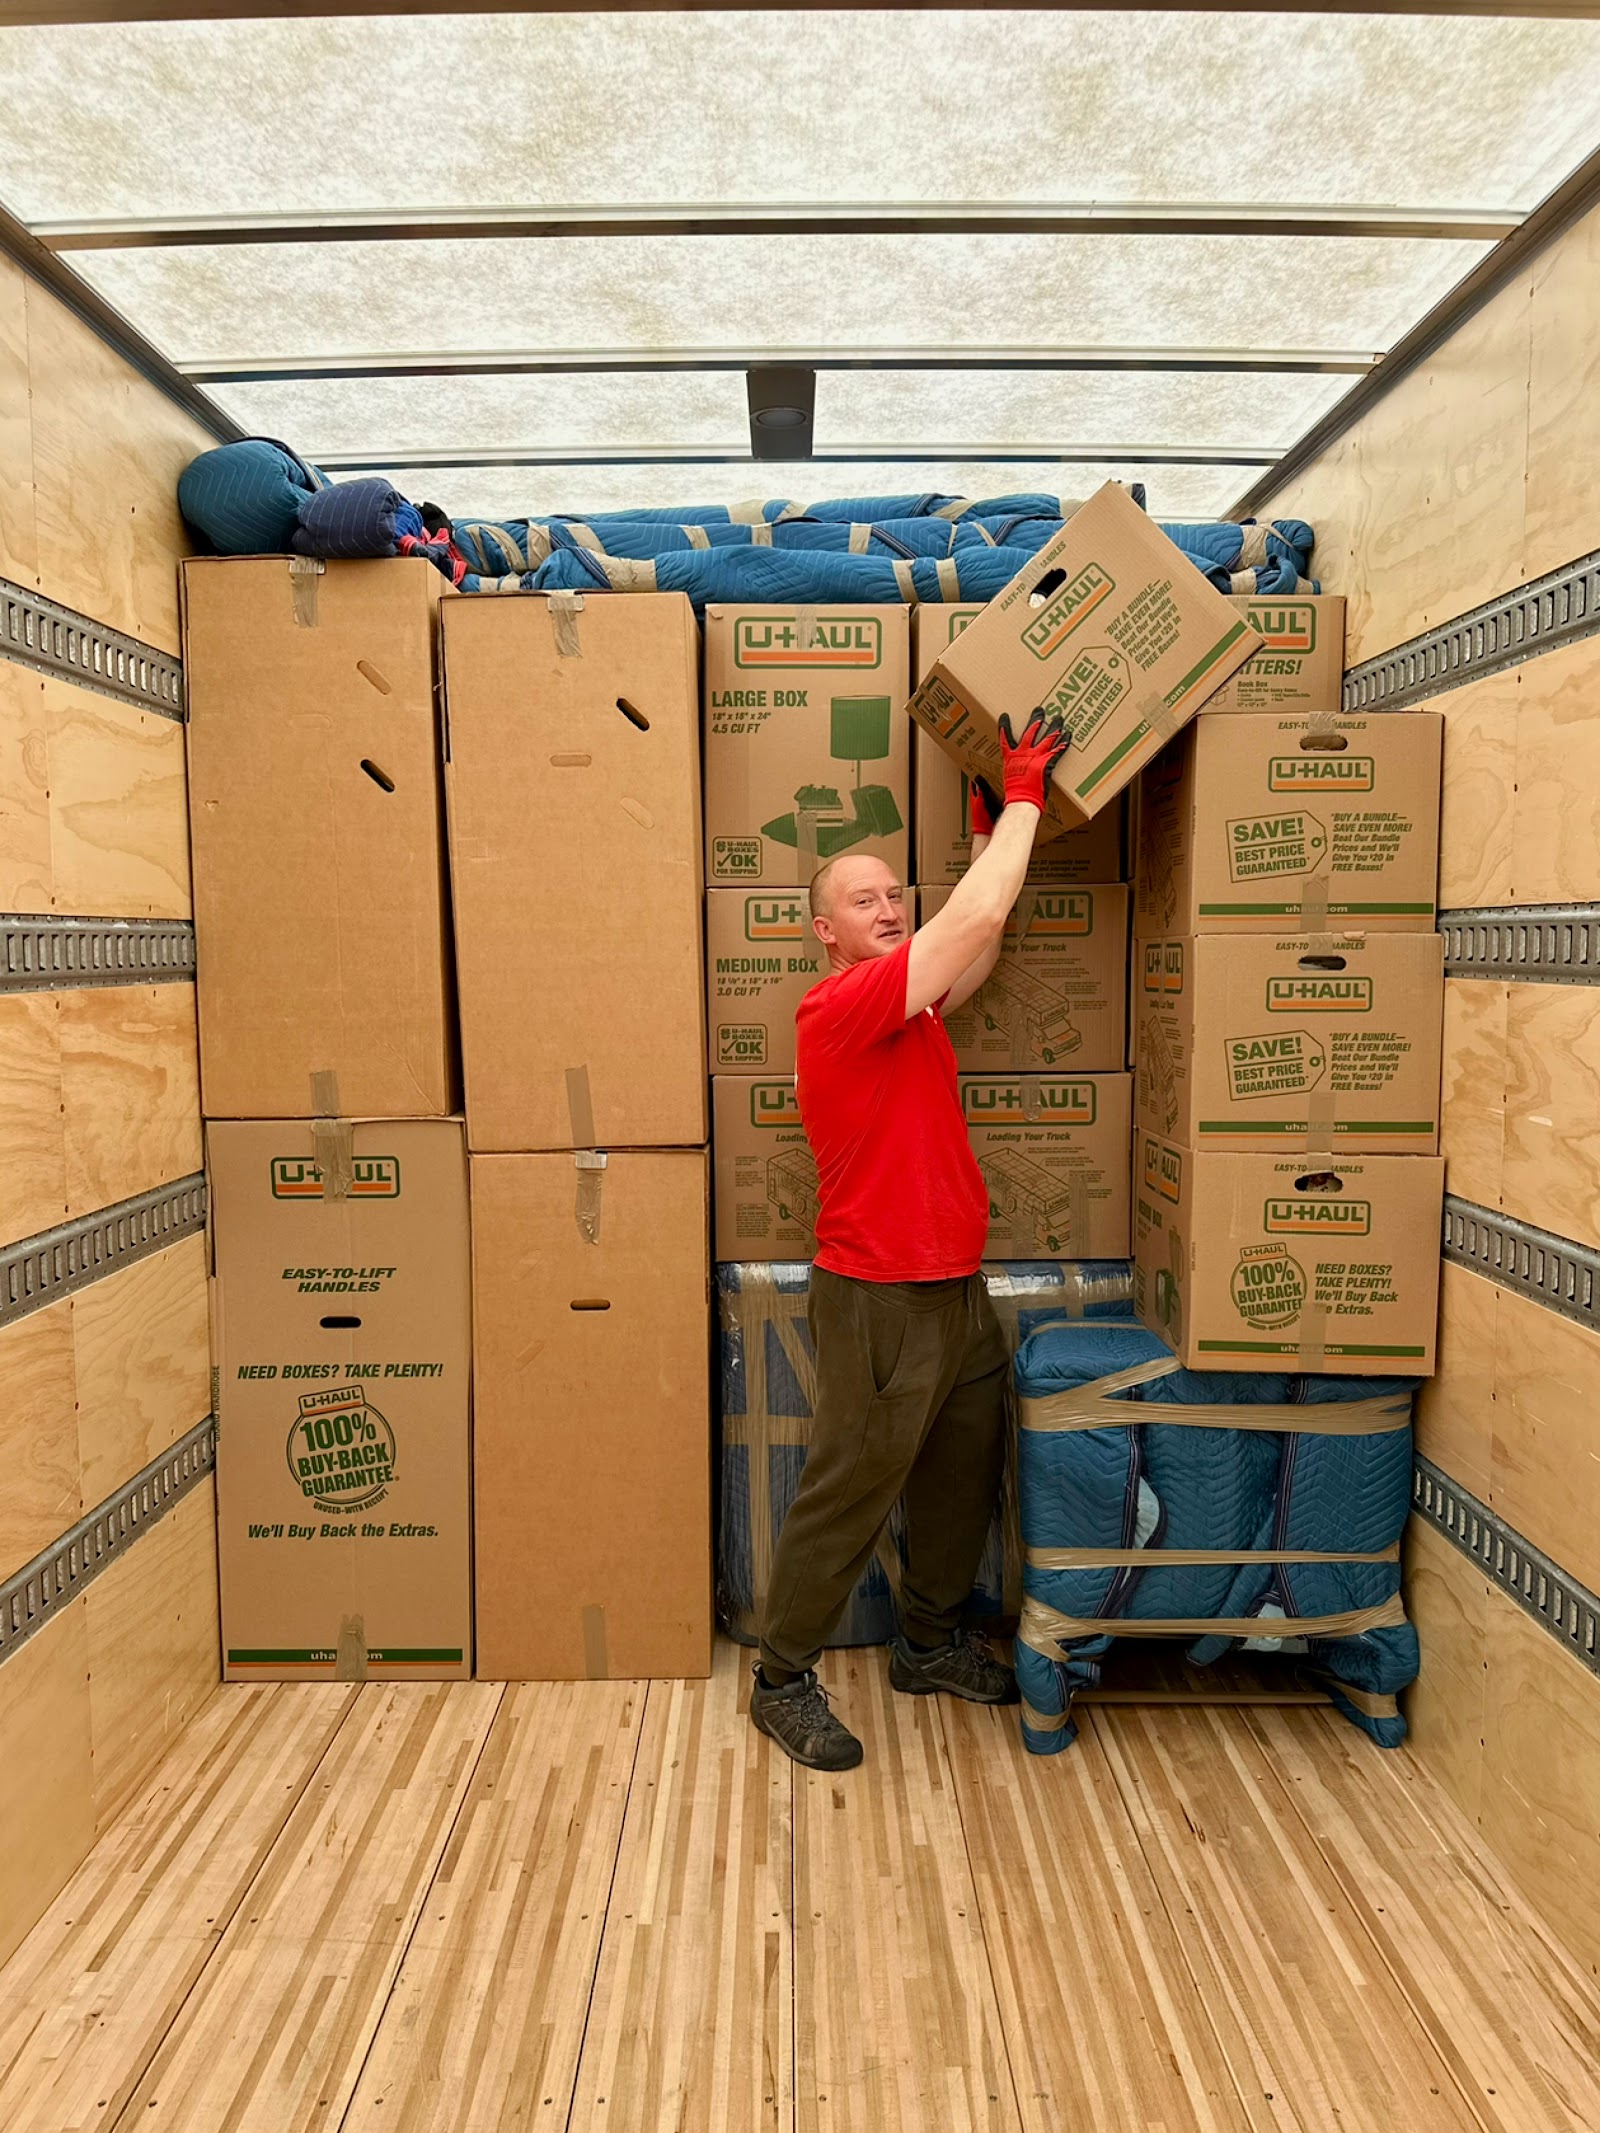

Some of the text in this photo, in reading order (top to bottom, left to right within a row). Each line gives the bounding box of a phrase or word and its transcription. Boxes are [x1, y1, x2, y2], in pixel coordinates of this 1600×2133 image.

[1000, 583, 1026, 611] EASY-TO
[1028, 575, 1102, 645] U-HAUL
[1114, 580, 1172, 642] SAVE EVEN MORE!
[1122, 611, 1129, 621] A
[1121, 597, 1172, 650] Beat Our Bundle
[1128, 603, 1178, 657] Prices and We'll
[1248, 612, 1306, 633] AUL
[1134, 648, 1150, 664] Give
[1149, 635, 1163, 648] You
[1141, 630, 1180, 672] FREE Boxes!
[1238, 660, 1302, 675] TTERS!
[1046, 656, 1098, 716] SAVE!
[712, 690, 808, 706] LARGE BOX
[1064, 674, 1113, 733] BEST PRICE
[1139, 686, 1185, 734] uhcom
[712, 724, 760, 733] 4.5 CU FT
[1278, 722, 1309, 730] EASY-TO
[1276, 763, 1366, 778] U-HAUL
[1234, 817, 1304, 842] SAVE!
[1333, 824, 1412, 832] SAVE EVEN MORE!
[1333, 834, 1400, 842] Beat Our Bundle
[1236, 844, 1304, 862] BEST PRICE
[1332, 844, 1399, 852] Prices and We'll
[731, 855, 758, 866] OK
[1332, 854, 1394, 862] Give You $20 in
[1032, 900, 1084, 918] AUL
[1020, 944, 1040, 952] Your
[1042, 944, 1066, 952] Truck
[1276, 942, 1309, 950] EASY-TO
[716, 958, 819, 972] MEDIUM BOX
[717, 987, 761, 996] 3.0 CU FT
[1274, 983, 1366, 998] U-HAUL
[736, 1042, 762, 1054] OK
[1233, 1037, 1302, 1060] SAVE!
[1332, 1043, 1411, 1052] SAVE EVEN MORE!
[1332, 1053, 1399, 1061] Beat Our Bundle
[1234, 1063, 1303, 1081] BEST PRICE
[1331, 1063, 1398, 1071] Prices and We'll
[1330, 1082, 1383, 1090] FREE Boxes!
[987, 1132, 1070, 1142] Loading Your Truck
[280, 1164, 391, 1182] U-UL
[1274, 1164, 1308, 1172] EASY-TO
[1272, 1205, 1364, 1221] U-HAUL
[1244, 1246, 1284, 1256] U-HAUL
[282, 1268, 396, 1280] EASY-TO-LIFT
[1240, 1260, 1295, 1287] 100%
[1316, 1264, 1392, 1275] NEED BOXES?
[298, 1282, 380, 1292] HANDLES
[1316, 1277, 1392, 1288] TAKE PLENTY!
[1238, 1282, 1302, 1303] BUY-BACK
[1315, 1290, 1398, 1303] We'll Buy Back
[1336, 1304, 1374, 1315] Extras.
[238, 1363, 443, 1379] NEED BOXES? TAKE PLENTY!
[303, 1390, 360, 1408] U-HAUL
[300, 1411, 376, 1452] 100%
[298, 1443, 389, 1477] BUY-BACK
[301, 1465, 393, 1497] GUARANTEE
[248, 1524, 438, 1540] We'll Buy Back the Extras.
